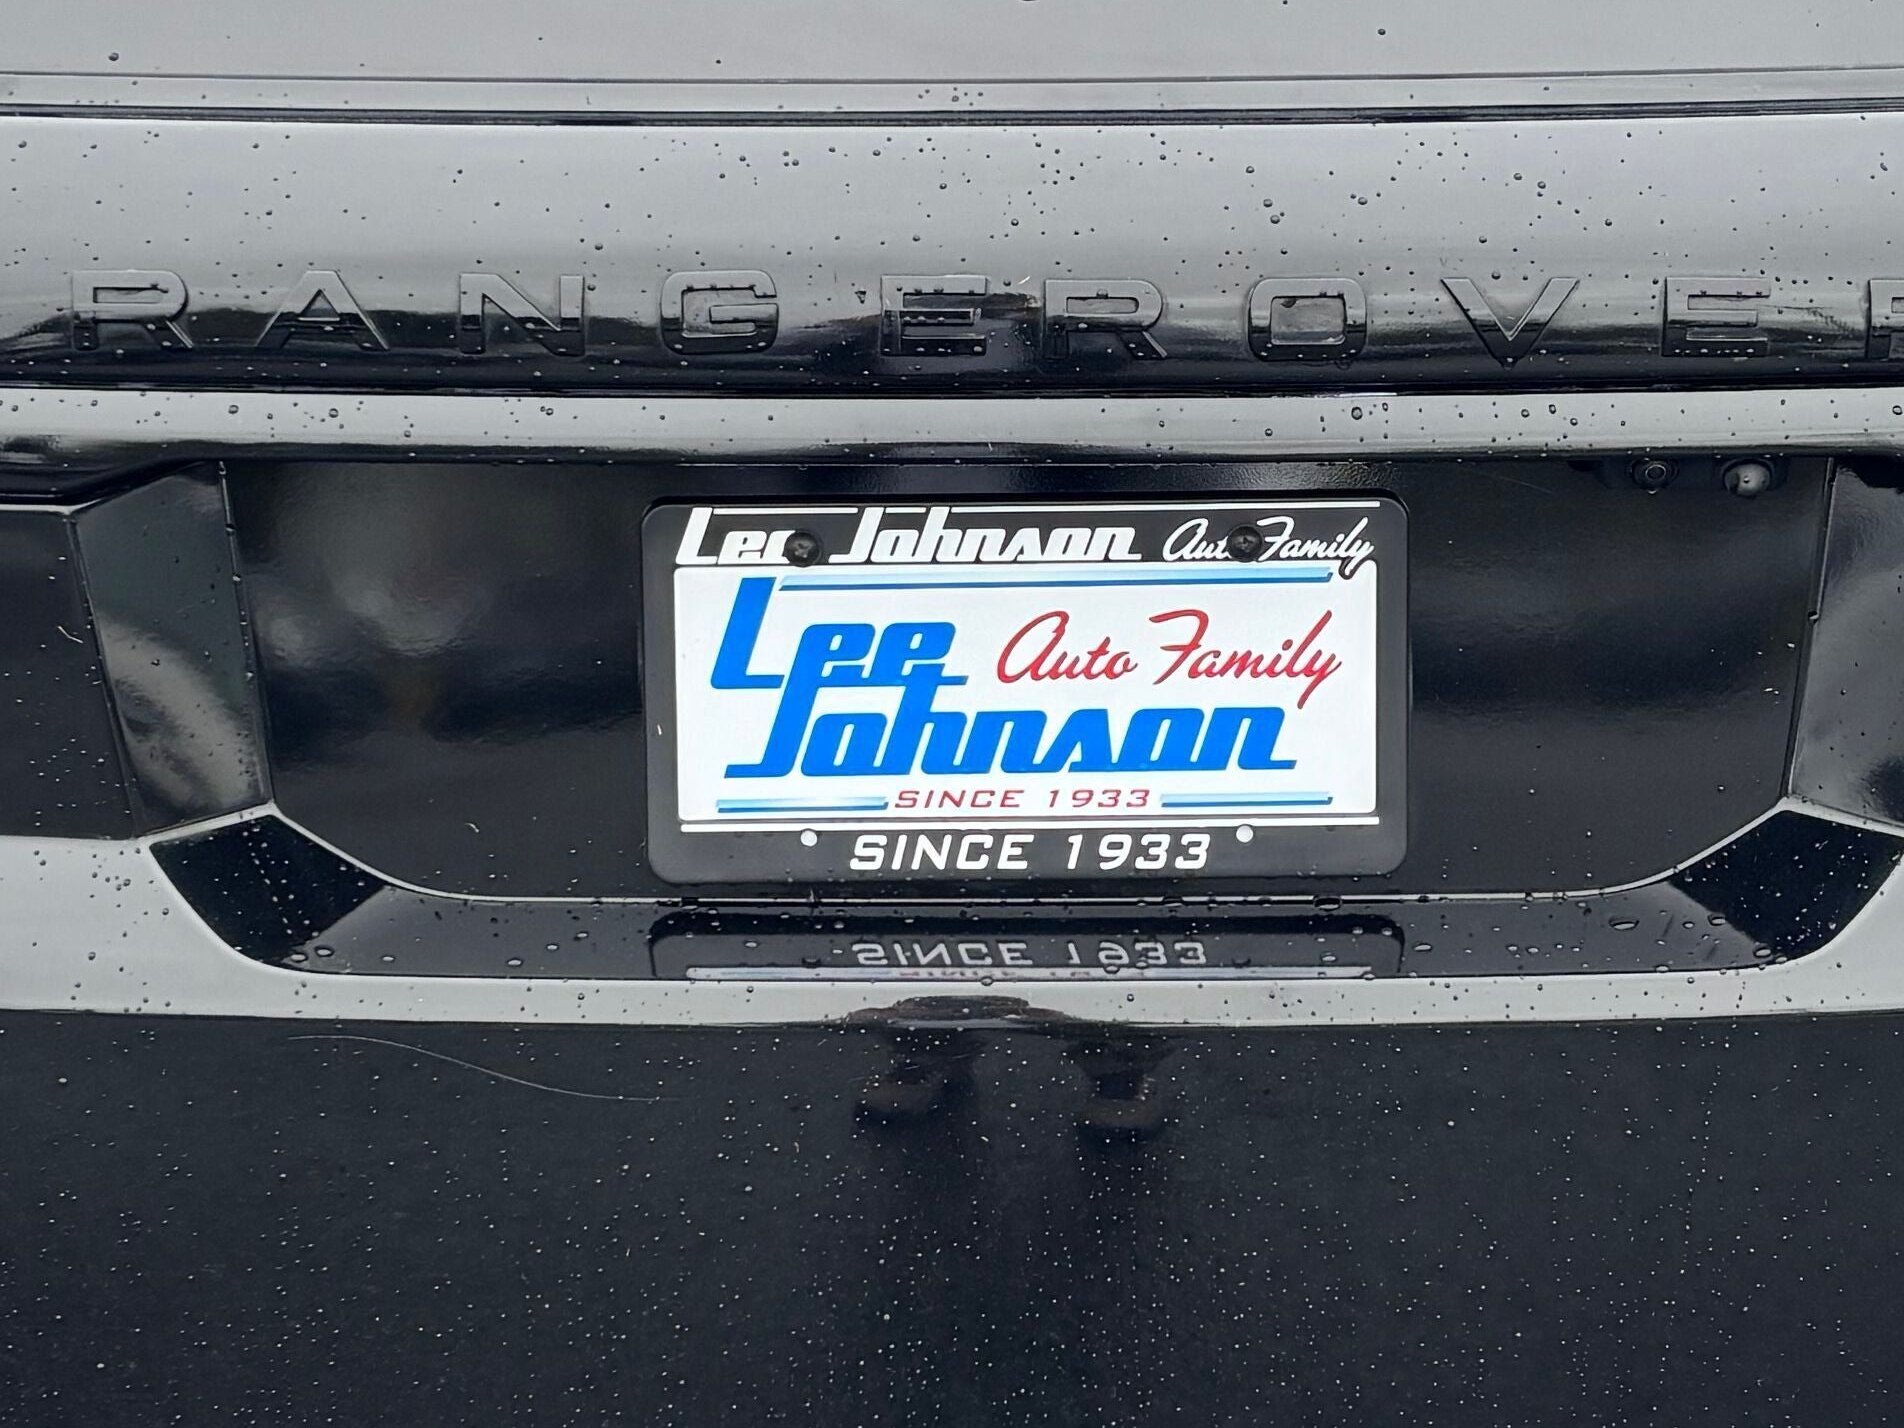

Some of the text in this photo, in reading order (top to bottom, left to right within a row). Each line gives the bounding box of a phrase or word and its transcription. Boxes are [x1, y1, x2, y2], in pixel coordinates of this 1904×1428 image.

[70, 269, 991, 357] RANGE
[828, 506, 1142, 564] Johnson
[1162, 517, 1236, 562] Aut
[1256, 515, 1376, 576] Family
[711, 576, 970, 686] Lee
[997, 608, 1343, 710] Auto Family
[724, 670, 1298, 778] Johnson
[894, 789, 1151, 809] SINCE 1933
[849, 833, 1211, 871] SINCE 1933
